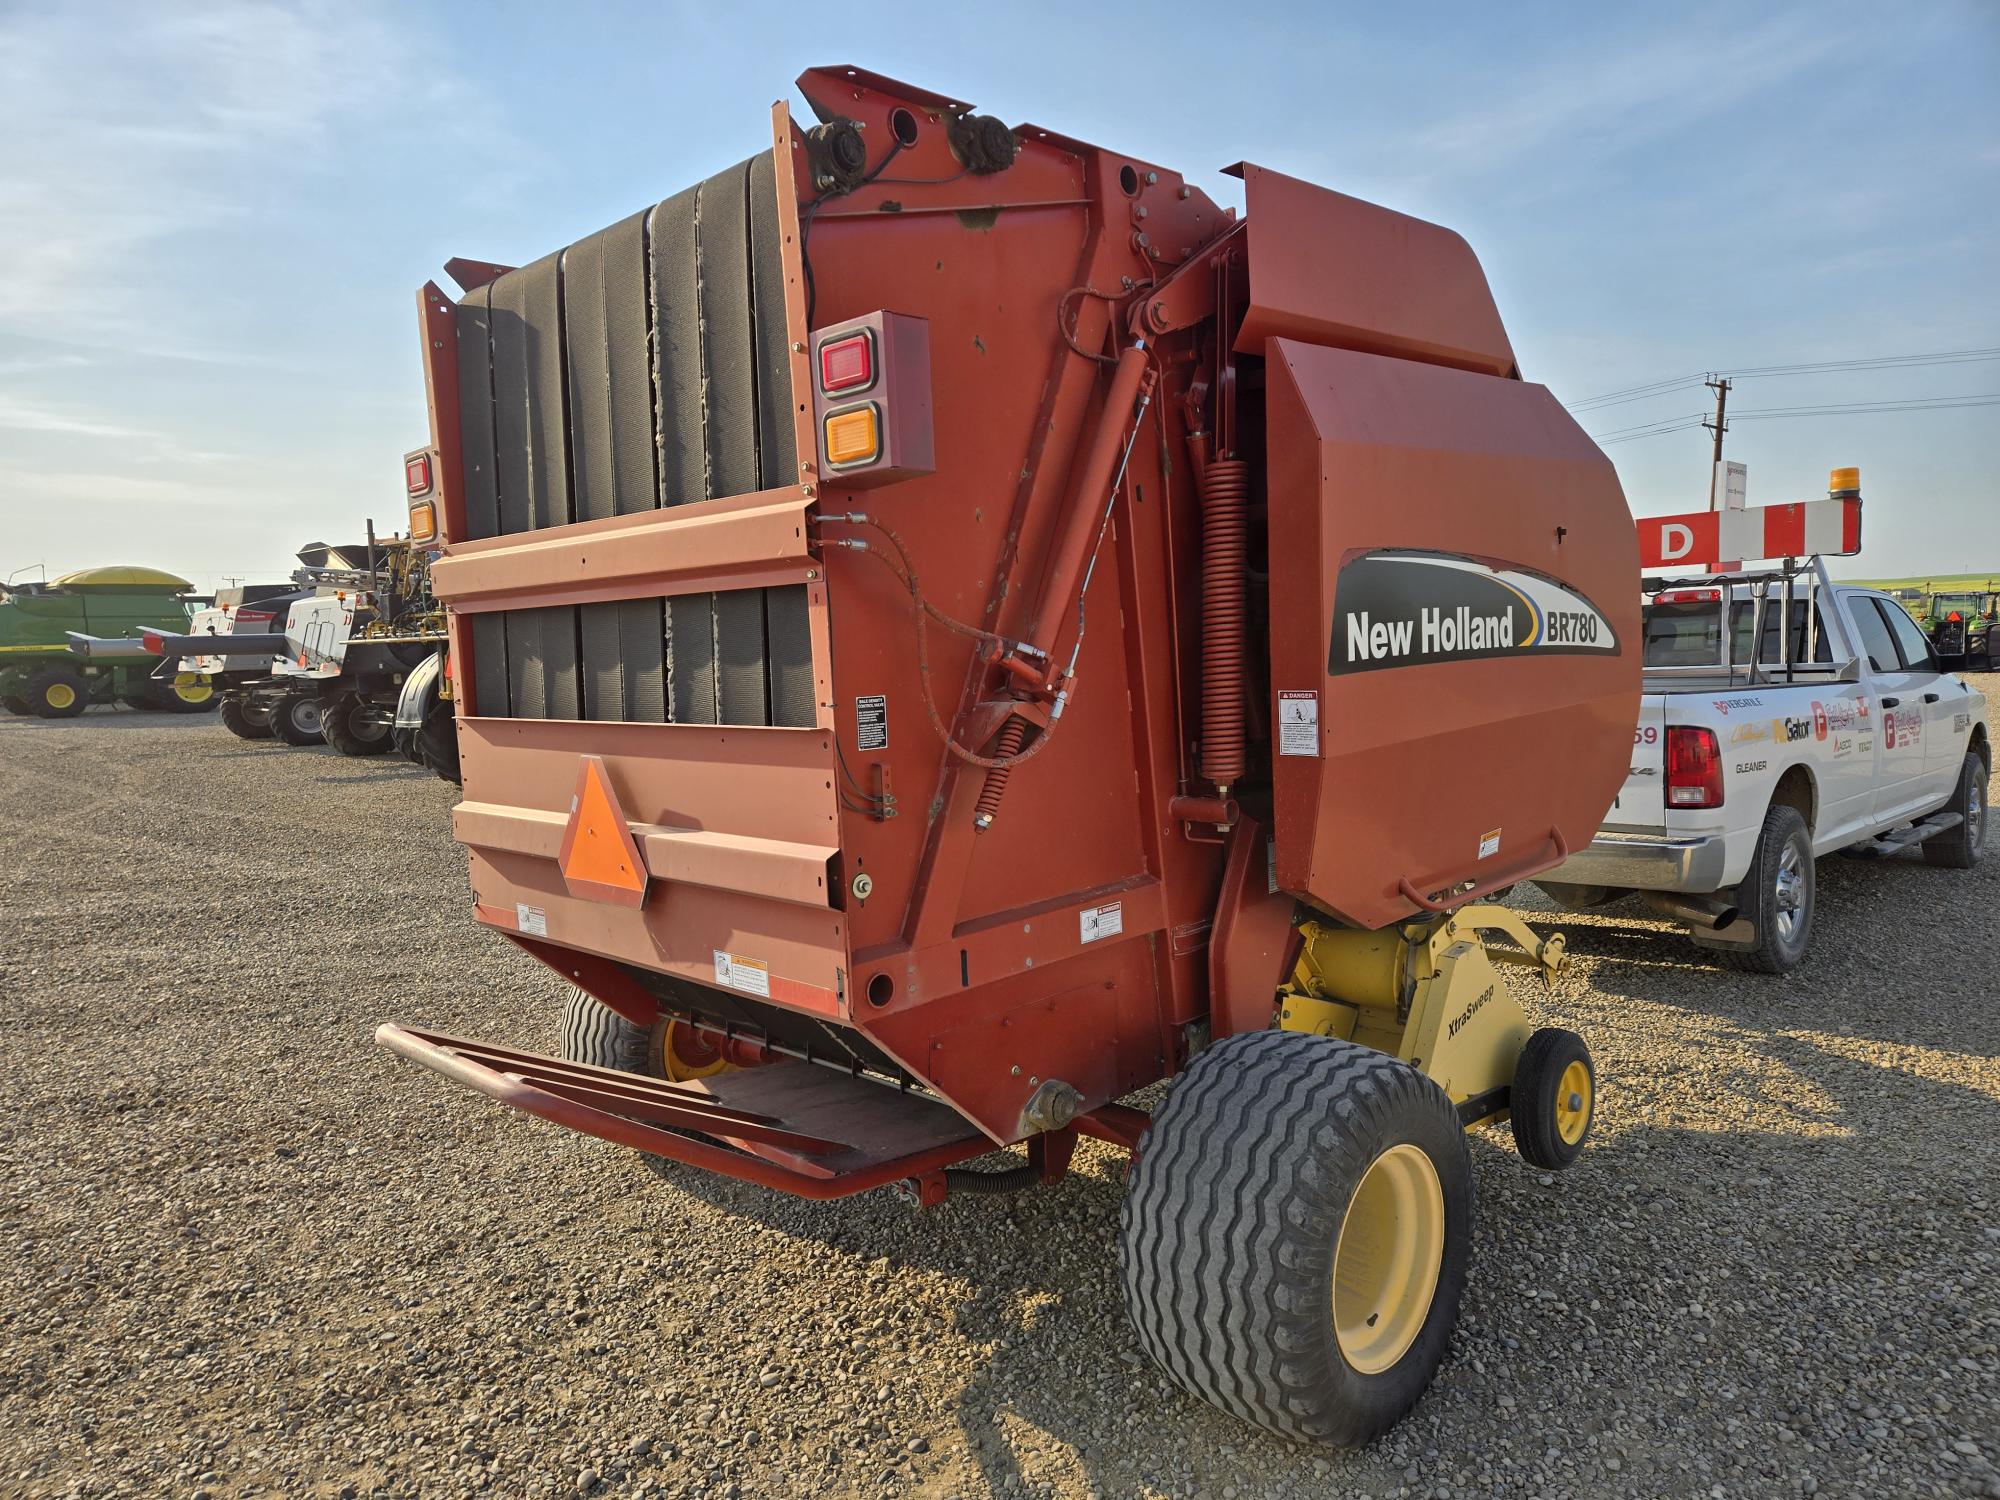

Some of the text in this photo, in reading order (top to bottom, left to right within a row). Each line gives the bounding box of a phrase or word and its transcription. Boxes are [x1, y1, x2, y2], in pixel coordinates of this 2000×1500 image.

[1661, 524, 1693, 560] D
[1347, 605, 1513, 662] New Holland
[1547, 611, 1597, 643] BR780
[1726, 697, 1763, 709] VERSATILE
[1736, 760, 1767, 774] GLEANER
[1448, 984, 1494, 1041] XtraSweep
